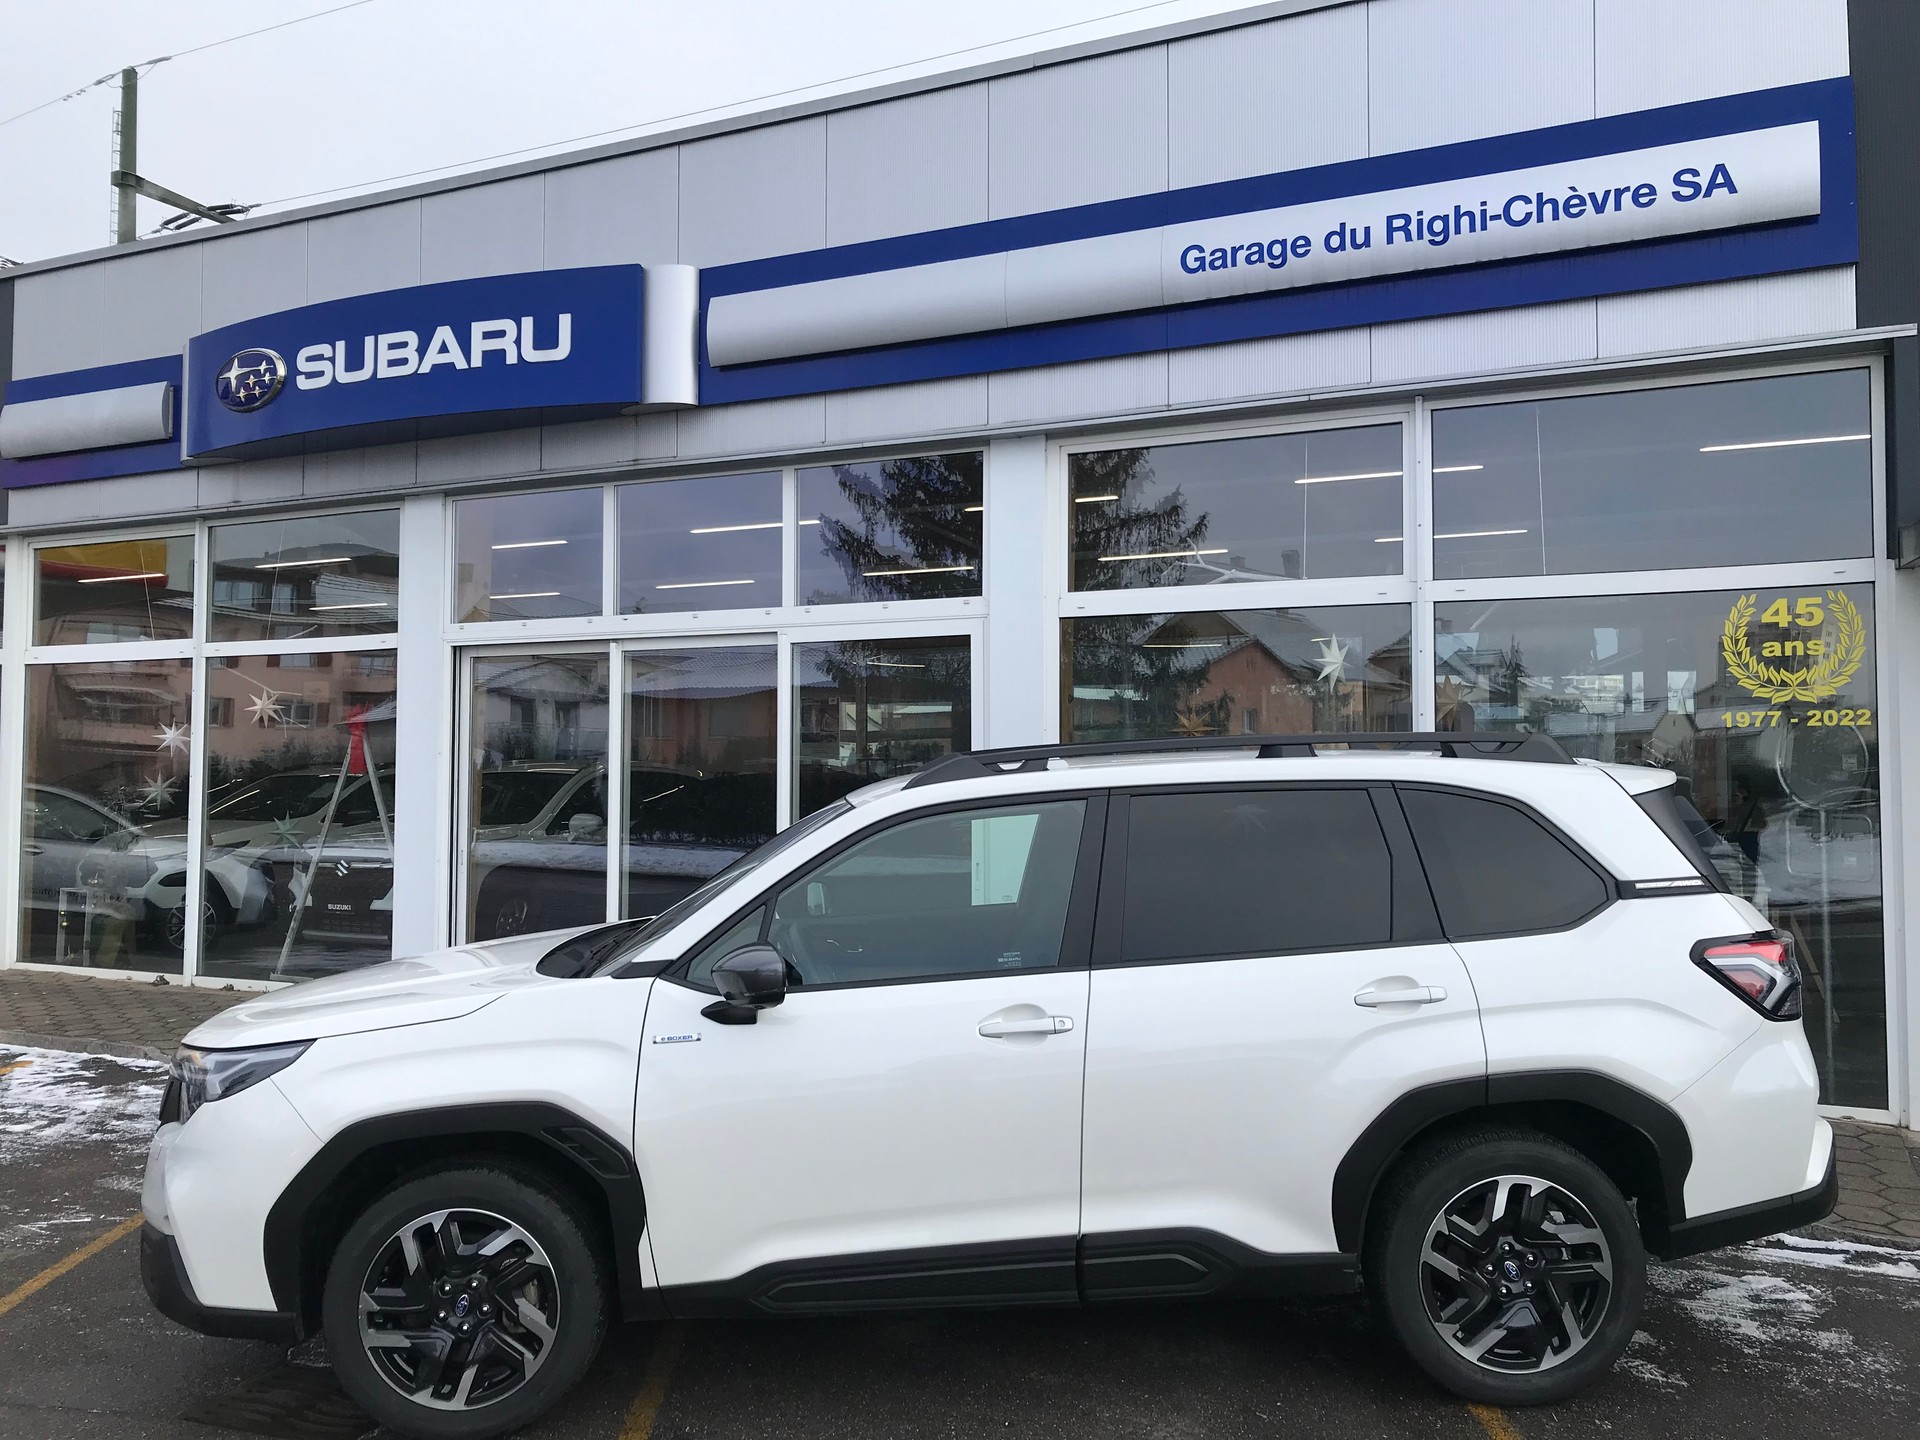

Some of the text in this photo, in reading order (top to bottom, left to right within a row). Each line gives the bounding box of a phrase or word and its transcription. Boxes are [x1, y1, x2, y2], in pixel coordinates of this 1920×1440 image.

[1180, 163, 1739, 275] Garage du Righi-Chèvre SA
[296, 313, 572, 391] SUBARU
[1760, 596, 1826, 628] 45
[1761, 639, 1827, 658] ans
[1721, 709, 1782, 728] 1977
[1807, 708, 1872, 727] 2022
[327, 903, 352, 911] SUZUKI
